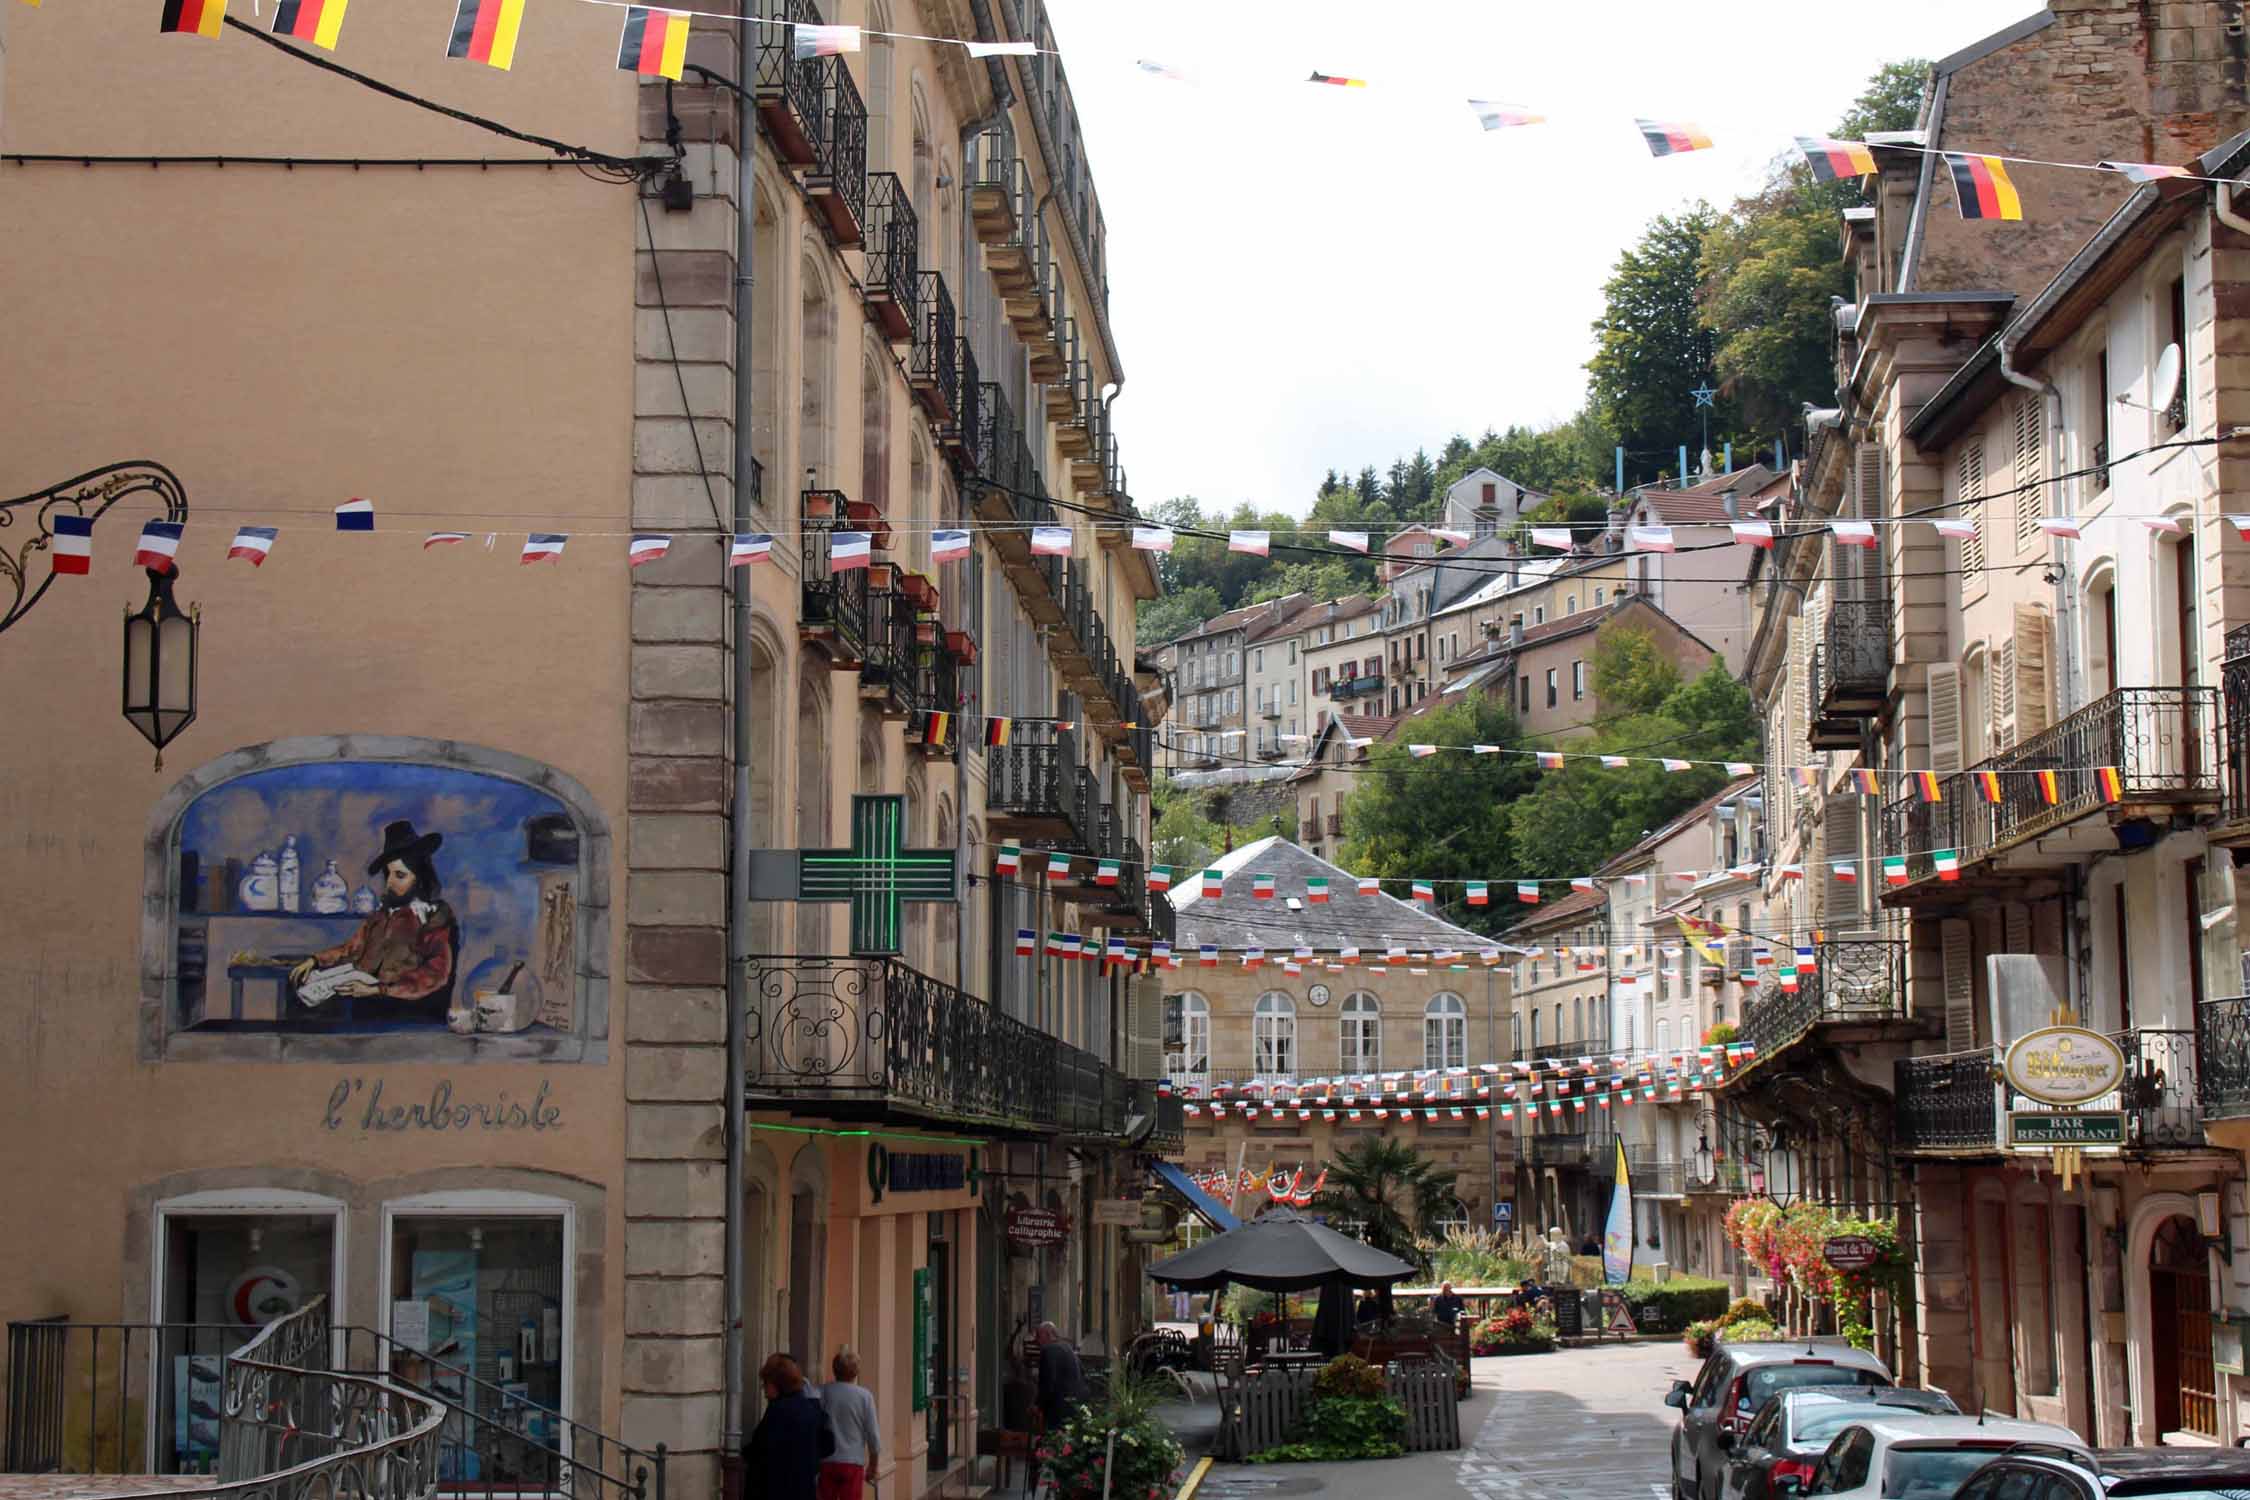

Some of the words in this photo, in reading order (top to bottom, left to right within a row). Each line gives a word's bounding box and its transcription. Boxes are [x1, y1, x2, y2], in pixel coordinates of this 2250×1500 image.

[321, 1078, 564, 1130] l'herboriste
[2049, 1117, 2084, 1128] BAR
[2016, 1129, 2118, 1140] RESTAURANT
